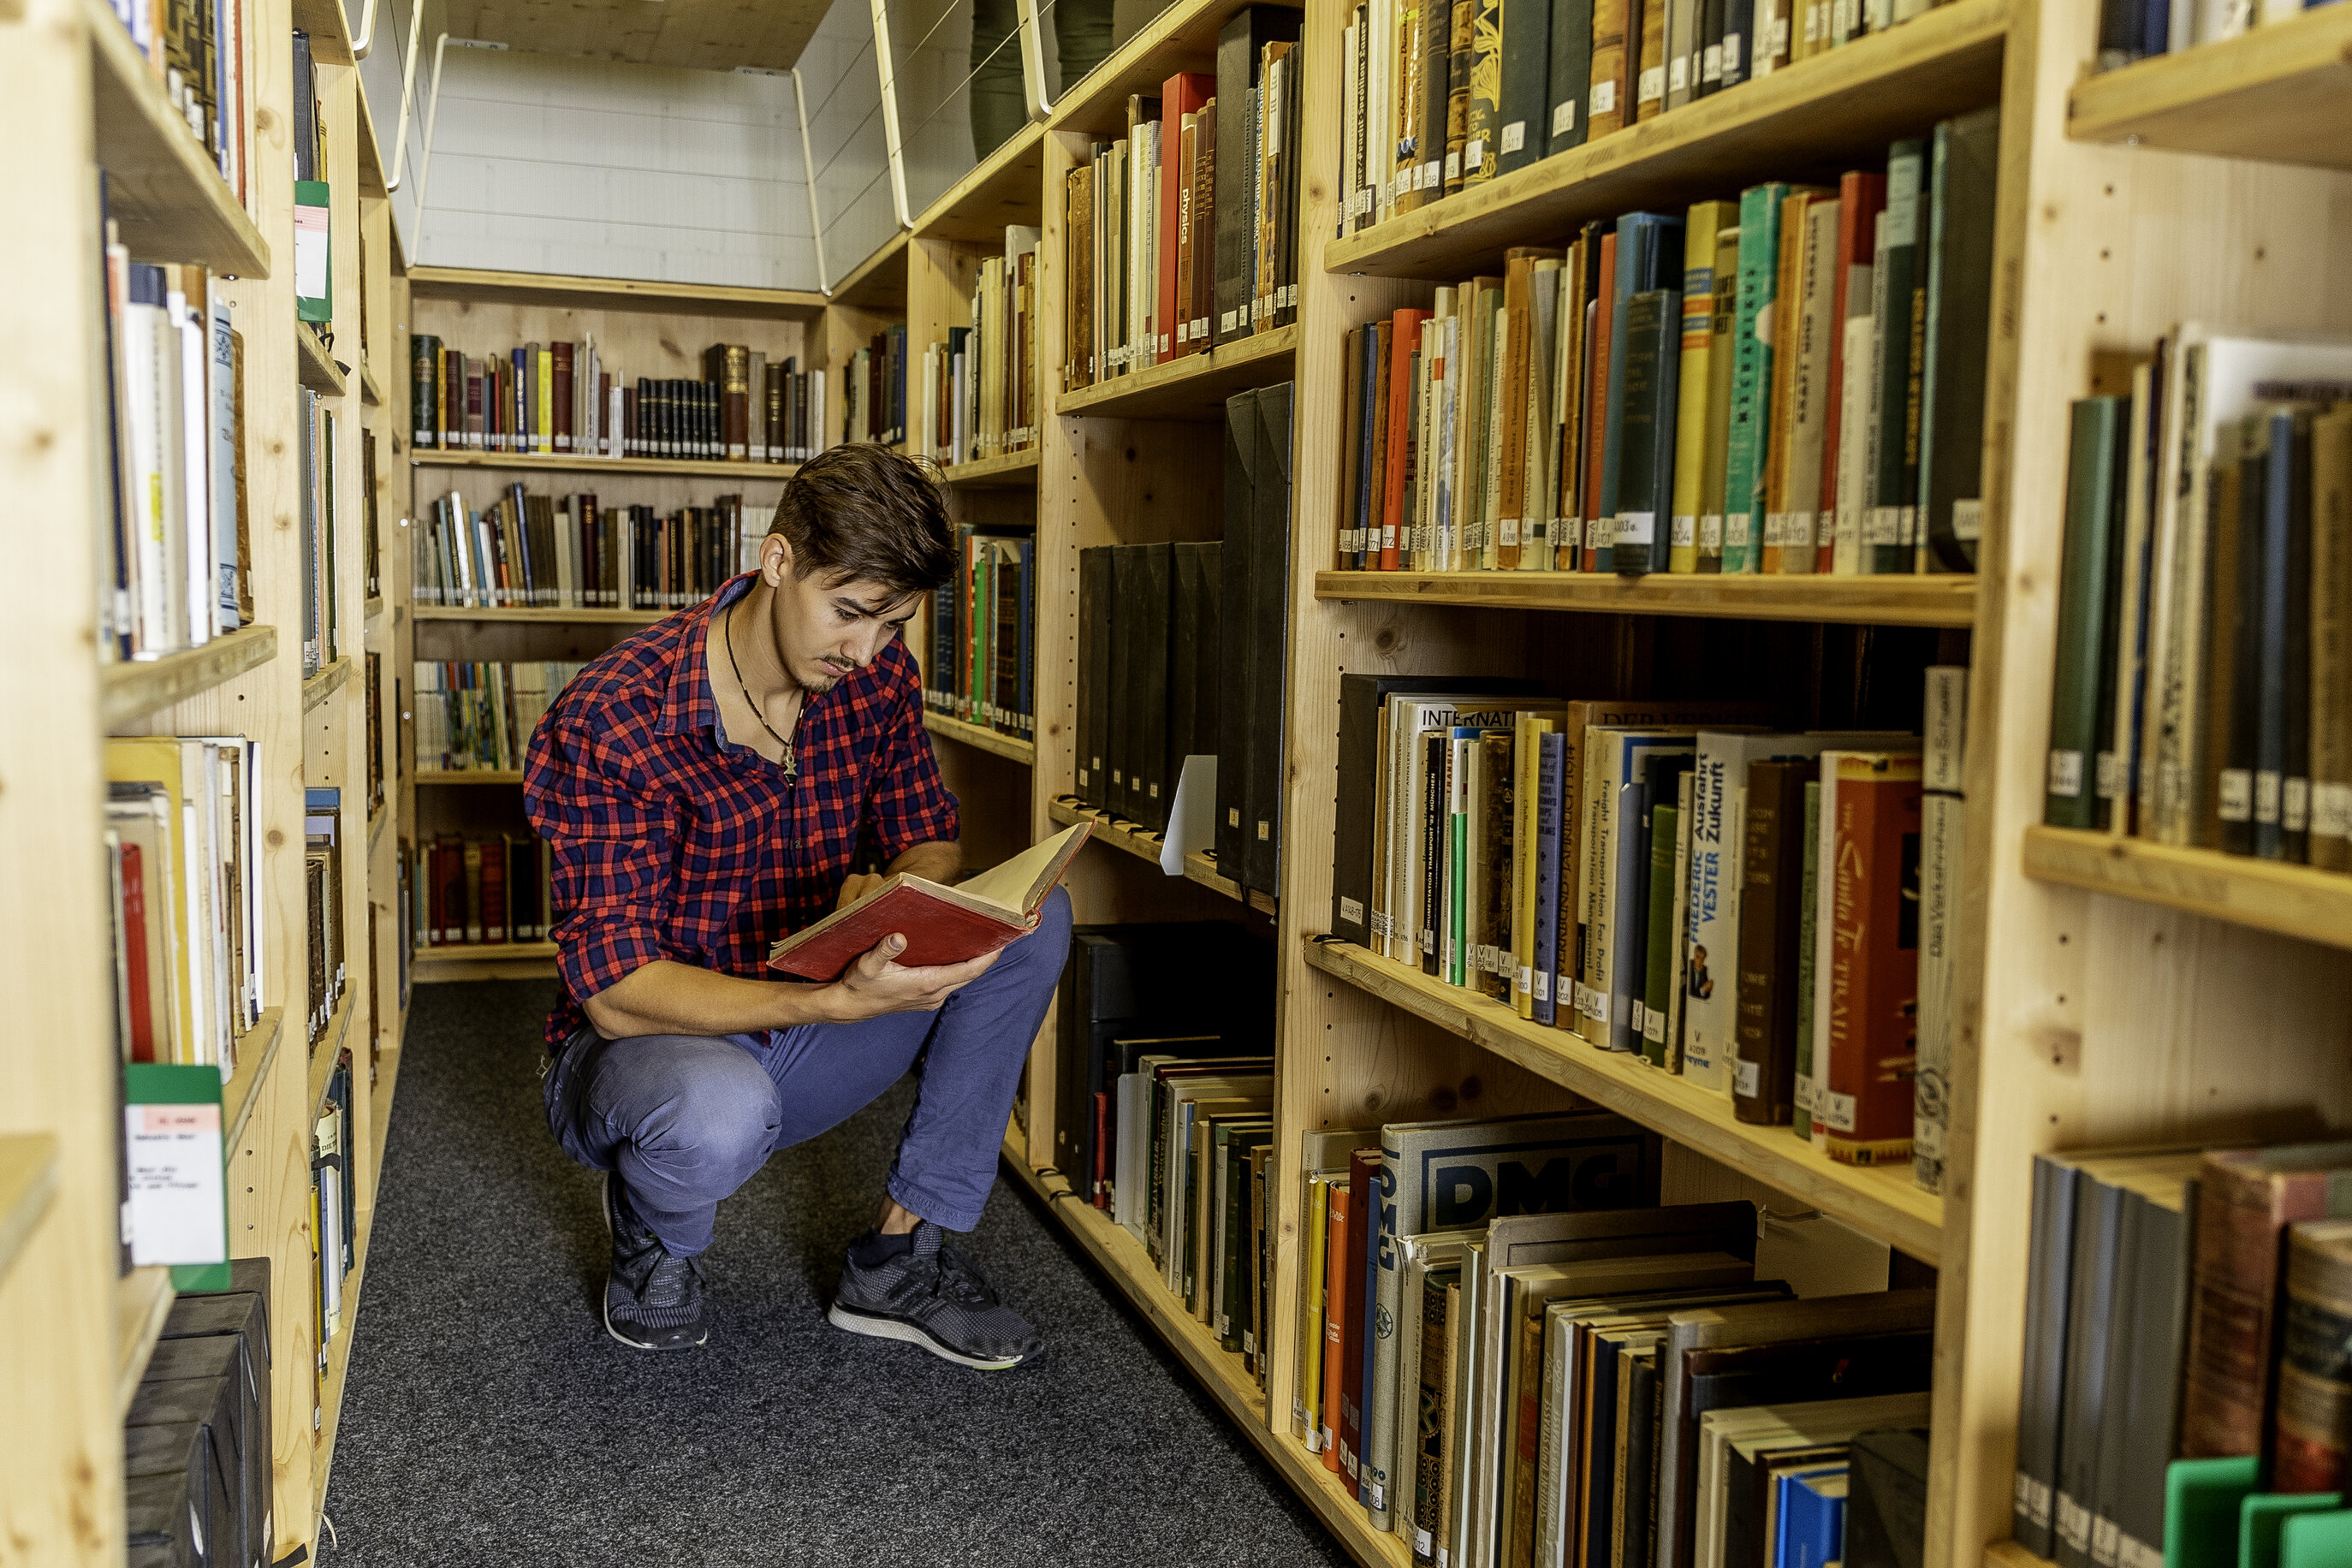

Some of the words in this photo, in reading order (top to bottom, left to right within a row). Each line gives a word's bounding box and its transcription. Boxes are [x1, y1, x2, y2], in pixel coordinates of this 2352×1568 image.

[1180, 187, 1191, 246] physics
[1523, 465, 1532, 517] ANDREAS
[1600, 780, 1611, 823] Freight
[1693, 751, 1708, 842] Ausfahrt
[1706, 761, 1725, 845] Zukunft
[1587, 799, 1600, 887] Transportation
[1595, 829, 1610, 918] Transportation
[1689, 849, 1703, 944] FREDERIC
[1701, 850, 1719, 924] VESTER
[1584, 891, 1598, 971] Management
[1595, 923, 1607, 944] For
[1595, 947, 1607, 983] Profit
[1541, 1398, 1553, 1445] STRASSE
[1550, 1408, 1560, 1453] STRASSE
[1541, 1446, 1550, 1471] UND
[1549, 1454, 1559, 1482] UND
[1539, 1470, 1550, 1520] SCHIENE
[1548, 1483, 1559, 1530] SCHIENE
